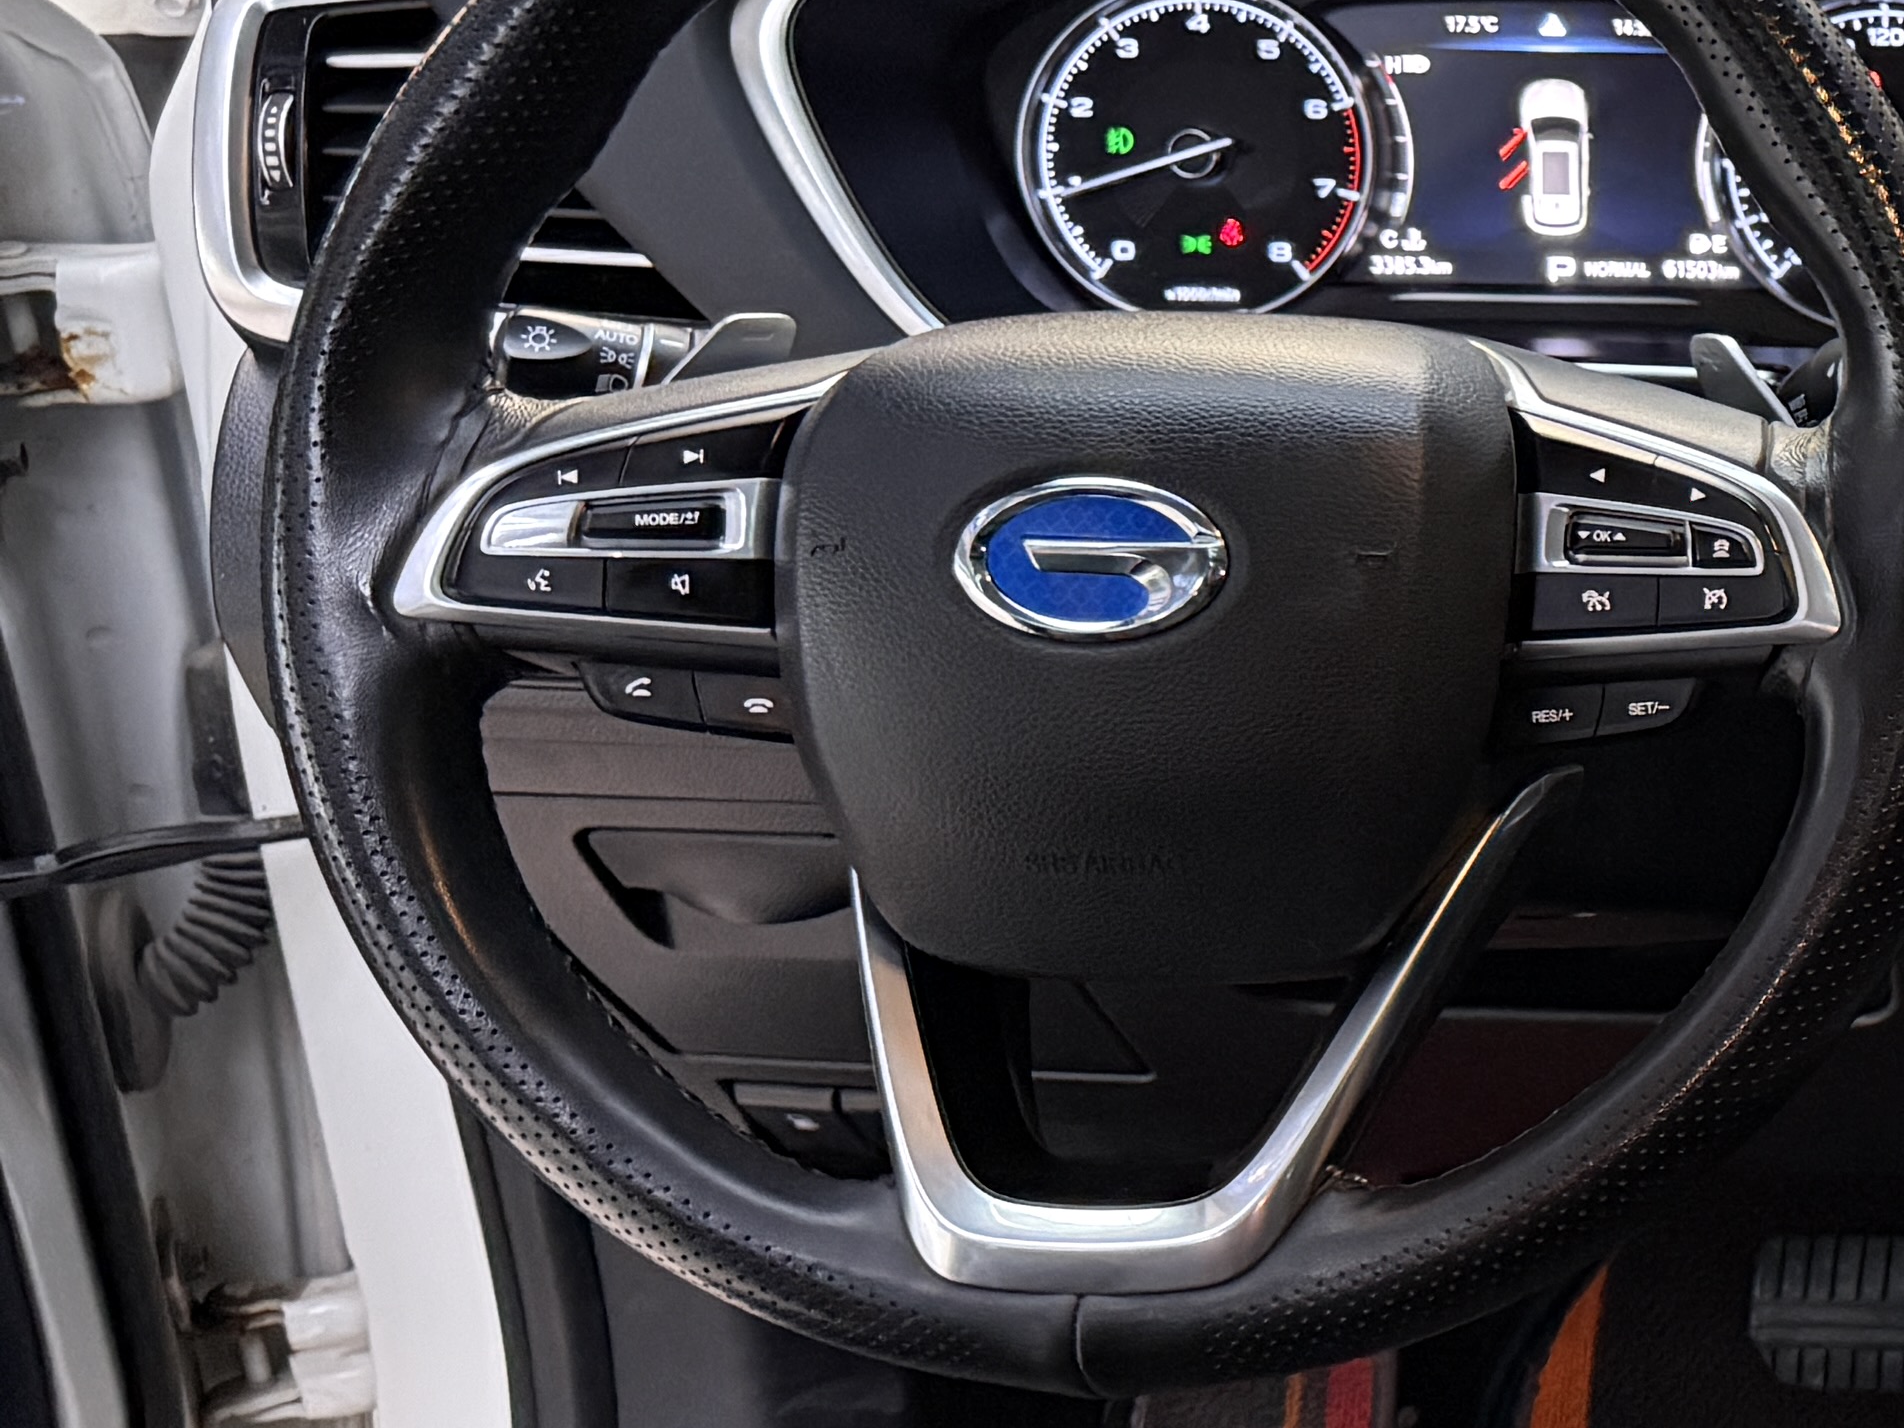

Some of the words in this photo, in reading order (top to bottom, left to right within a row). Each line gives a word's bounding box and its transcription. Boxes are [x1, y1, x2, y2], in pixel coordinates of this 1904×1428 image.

[1185, 13, 1210, 35] 4
[1867, 28, 1904, 47] 120
[1115, 38, 1140, 59] 3
[1256, 39, 1281, 60] 5
[1069, 97, 1094, 119] 2
[1304, 99, 1329, 120] 6
[1312, 177, 1337, 199] 7
[1110, 239, 1136, 261] 0
[1267, 241, 1294, 262] 8
[594, 329, 639, 346] AUTO
[1592, 530, 1612, 543] OK
[1531, 708, 1574, 724] RES/+
